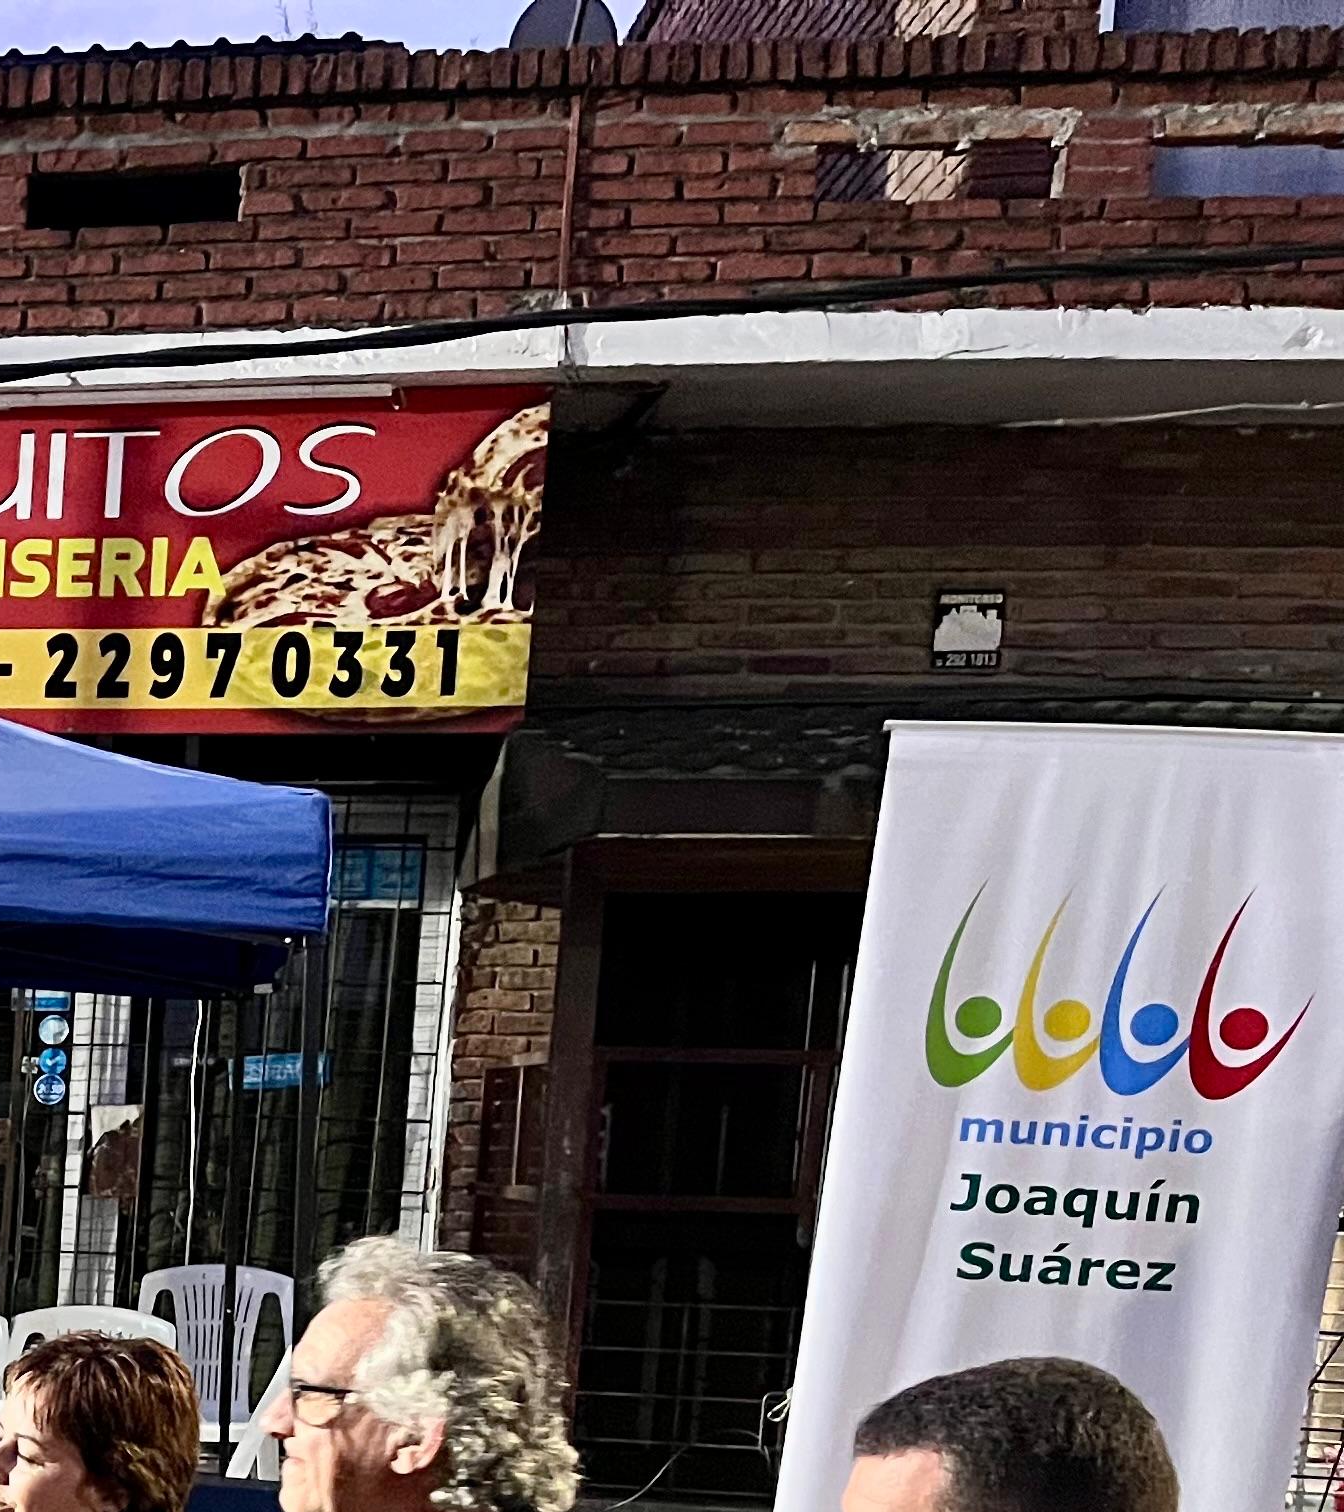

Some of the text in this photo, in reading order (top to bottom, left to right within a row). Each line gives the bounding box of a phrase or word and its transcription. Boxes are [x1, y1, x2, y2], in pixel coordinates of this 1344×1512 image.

[959, 1115, 1213, 1160] municipio
[949, 1173, 1201, 1228] Joaquín
[956, 1241, 1176, 1292] Suárez
